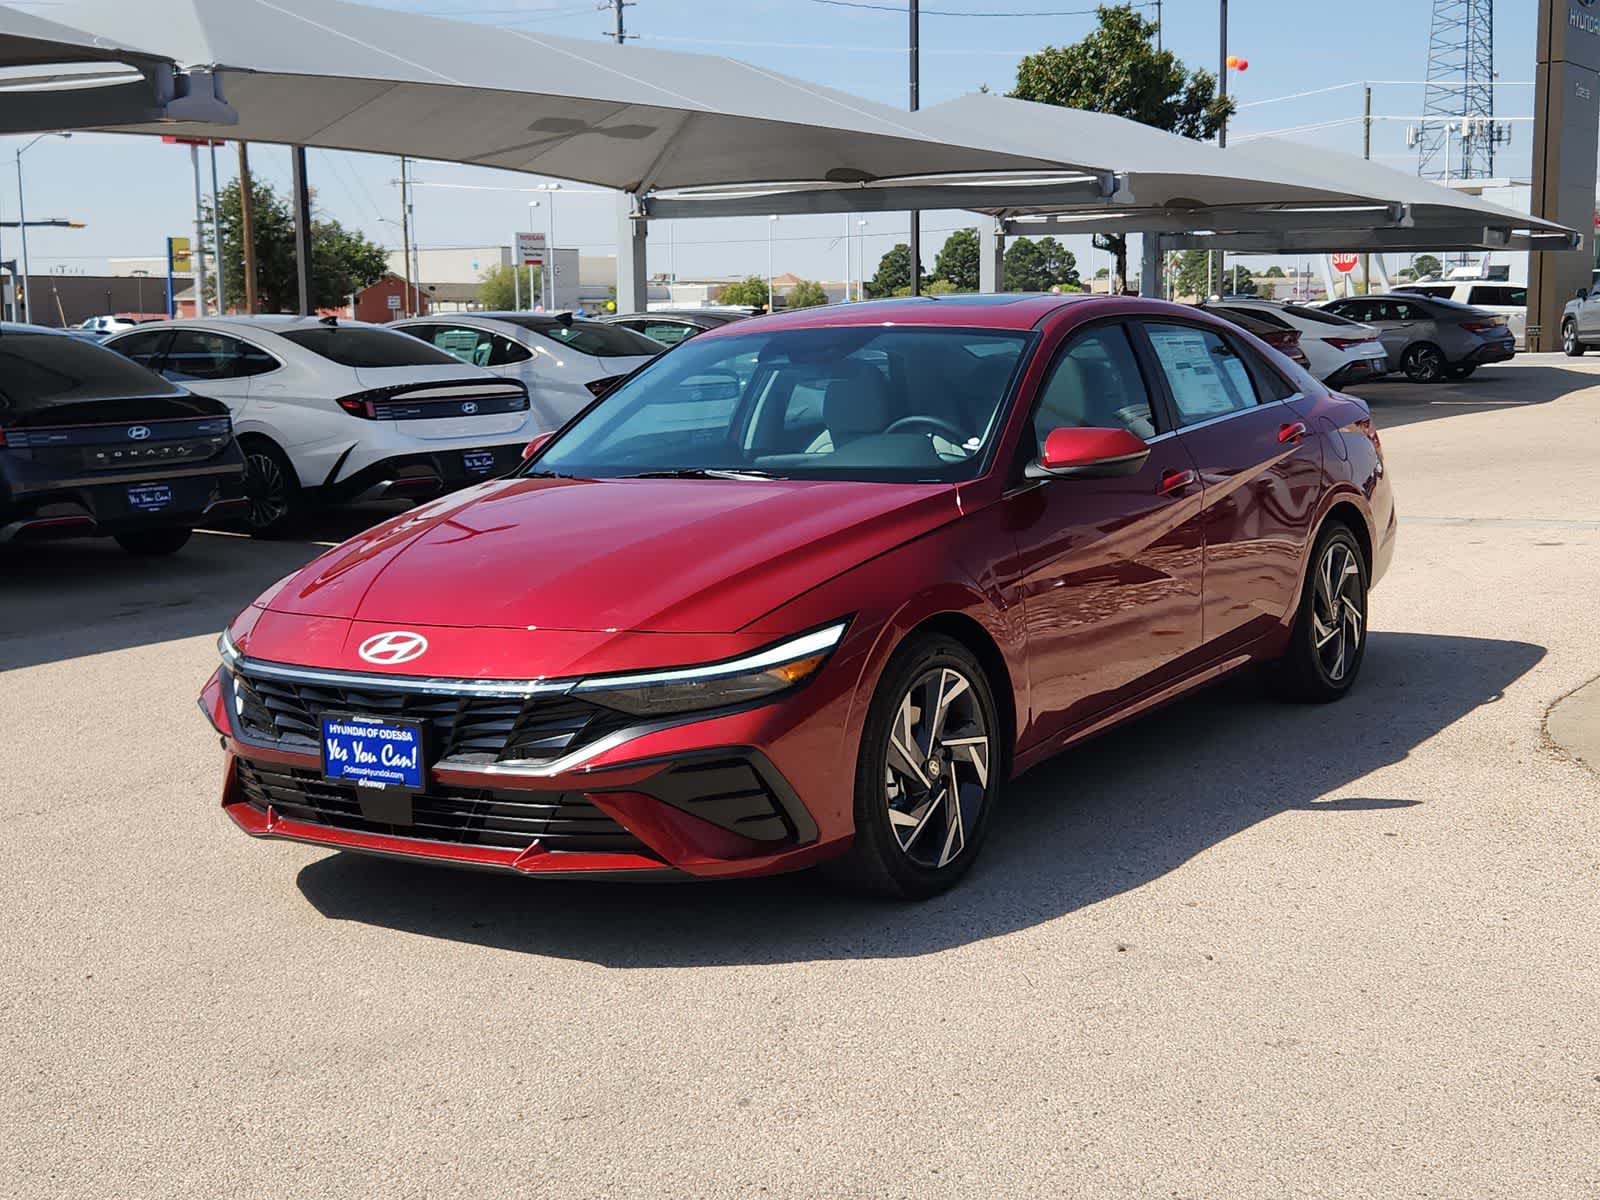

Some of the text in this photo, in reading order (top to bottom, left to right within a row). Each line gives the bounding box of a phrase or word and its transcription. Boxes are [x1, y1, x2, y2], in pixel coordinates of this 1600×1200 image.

[1569, 7, 1600, 35] HYUNDA
[1334, 253, 1356, 264] STOP
[96, 446, 192, 458] SONATA
[329, 724, 413, 741] HYUNDAI OF ODESSA
[327, 738, 417, 769] Yes You Can!
[343, 765, 404, 779] OdessaHyundai.com
[358, 778, 386, 790] driveway
